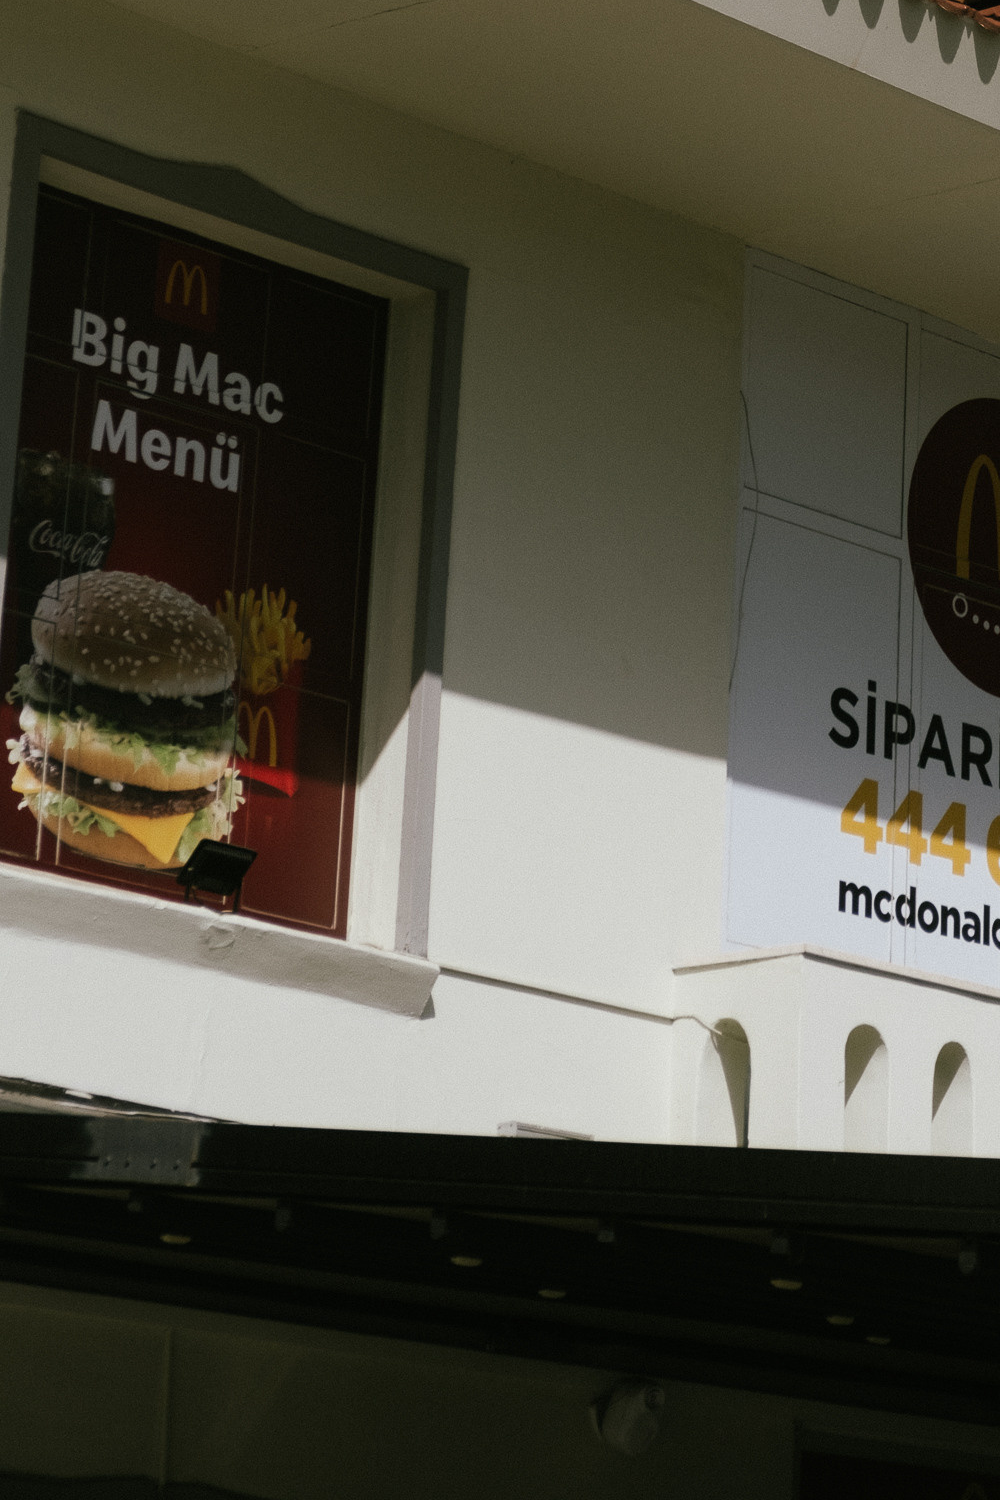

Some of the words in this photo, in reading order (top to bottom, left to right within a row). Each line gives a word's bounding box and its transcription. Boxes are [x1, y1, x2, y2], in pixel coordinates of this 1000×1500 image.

[71, 307, 160, 400] Big
[173, 342, 284, 425] Mac
[90, 398, 241, 494] Menü
[840, 777, 972, 878] 444
